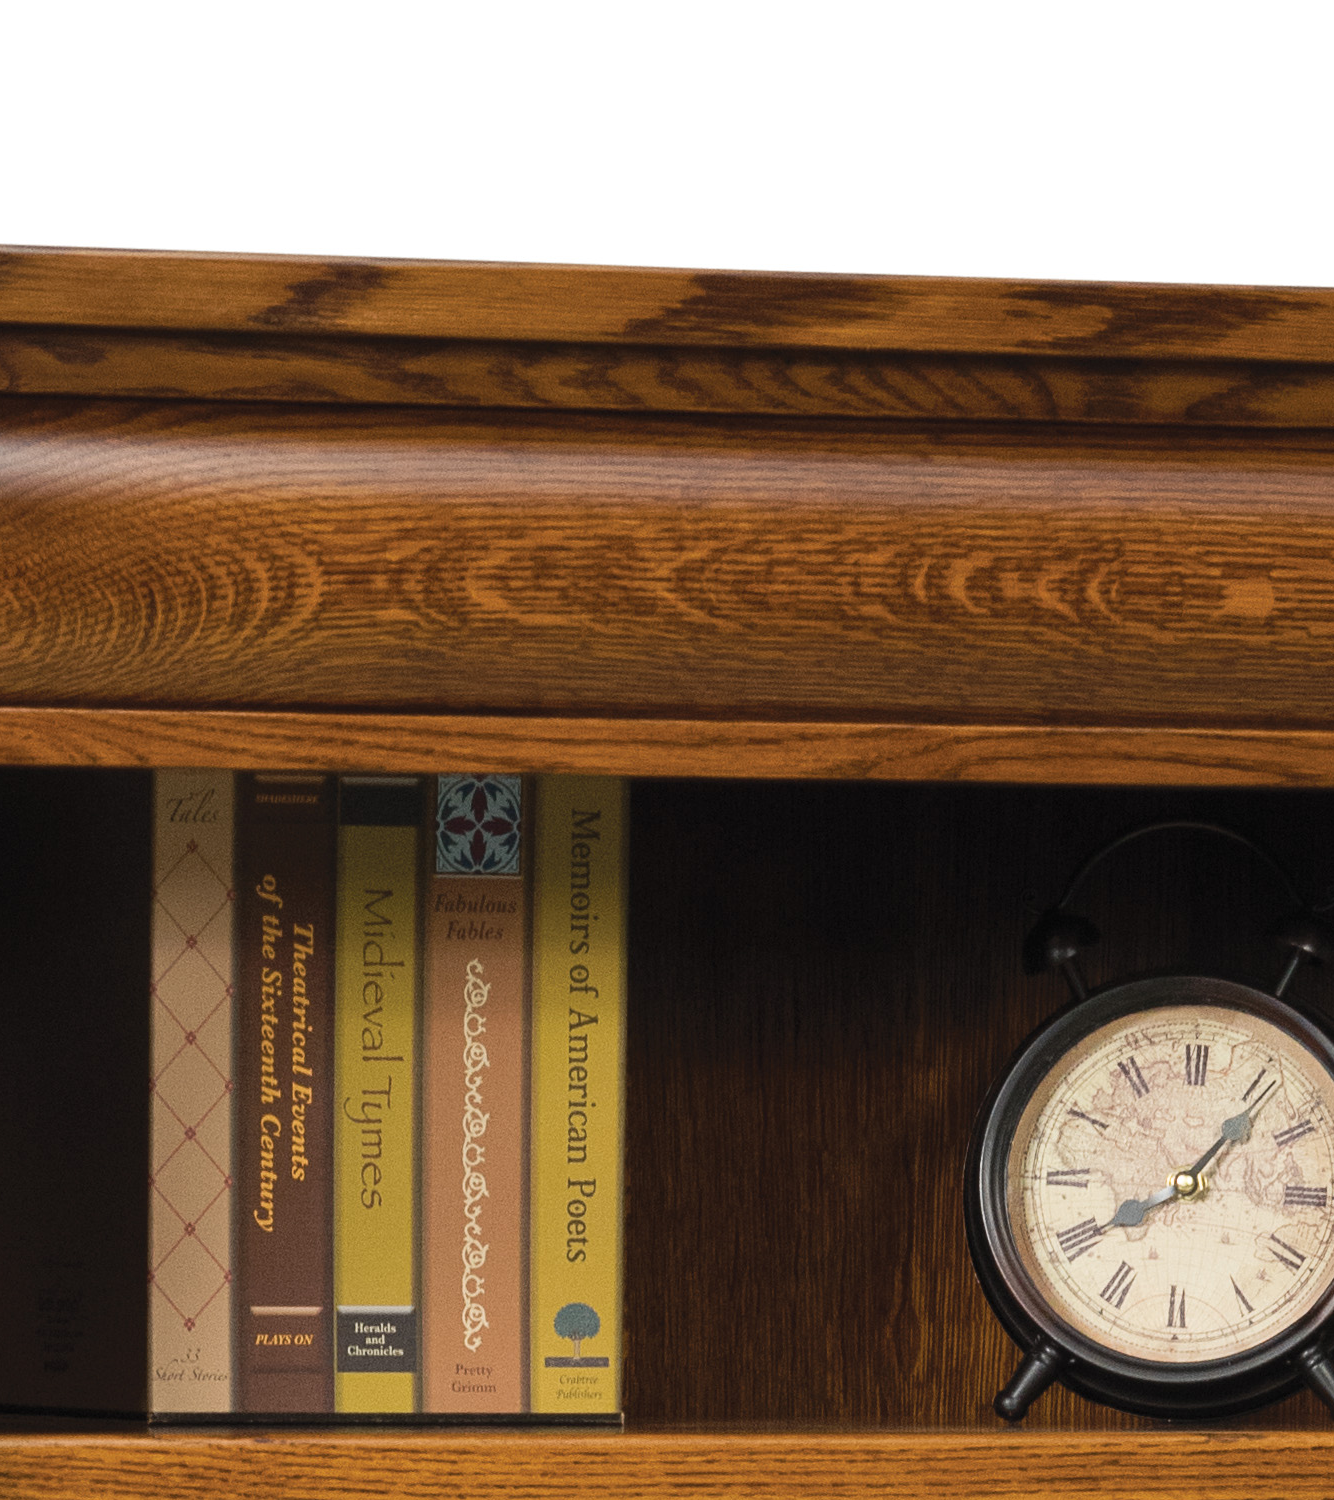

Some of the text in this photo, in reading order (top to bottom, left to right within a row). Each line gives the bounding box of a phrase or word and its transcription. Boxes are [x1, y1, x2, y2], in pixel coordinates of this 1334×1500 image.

[434, 893, 517, 914] Fabulous
[446, 919, 504, 941] Fables
[565, 808, 601, 1263] Memoirs of American Poets
[253, 874, 283, 1232] of the Sixteenth Century
[290, 922, 315, 1182] Theatrical Events
[343, 888, 405, 1210] Midieval Tymes
[354, 1323, 397, 1334] Heralds
[254, 1333, 315, 1346] PLAYS ON
[365, 1334, 386, 1345] and
[347, 1345, 405, 1357] Chronicles
[454, 1363, 494, 1379] Pretty
[451, 1380, 497, 1395] Grimm
